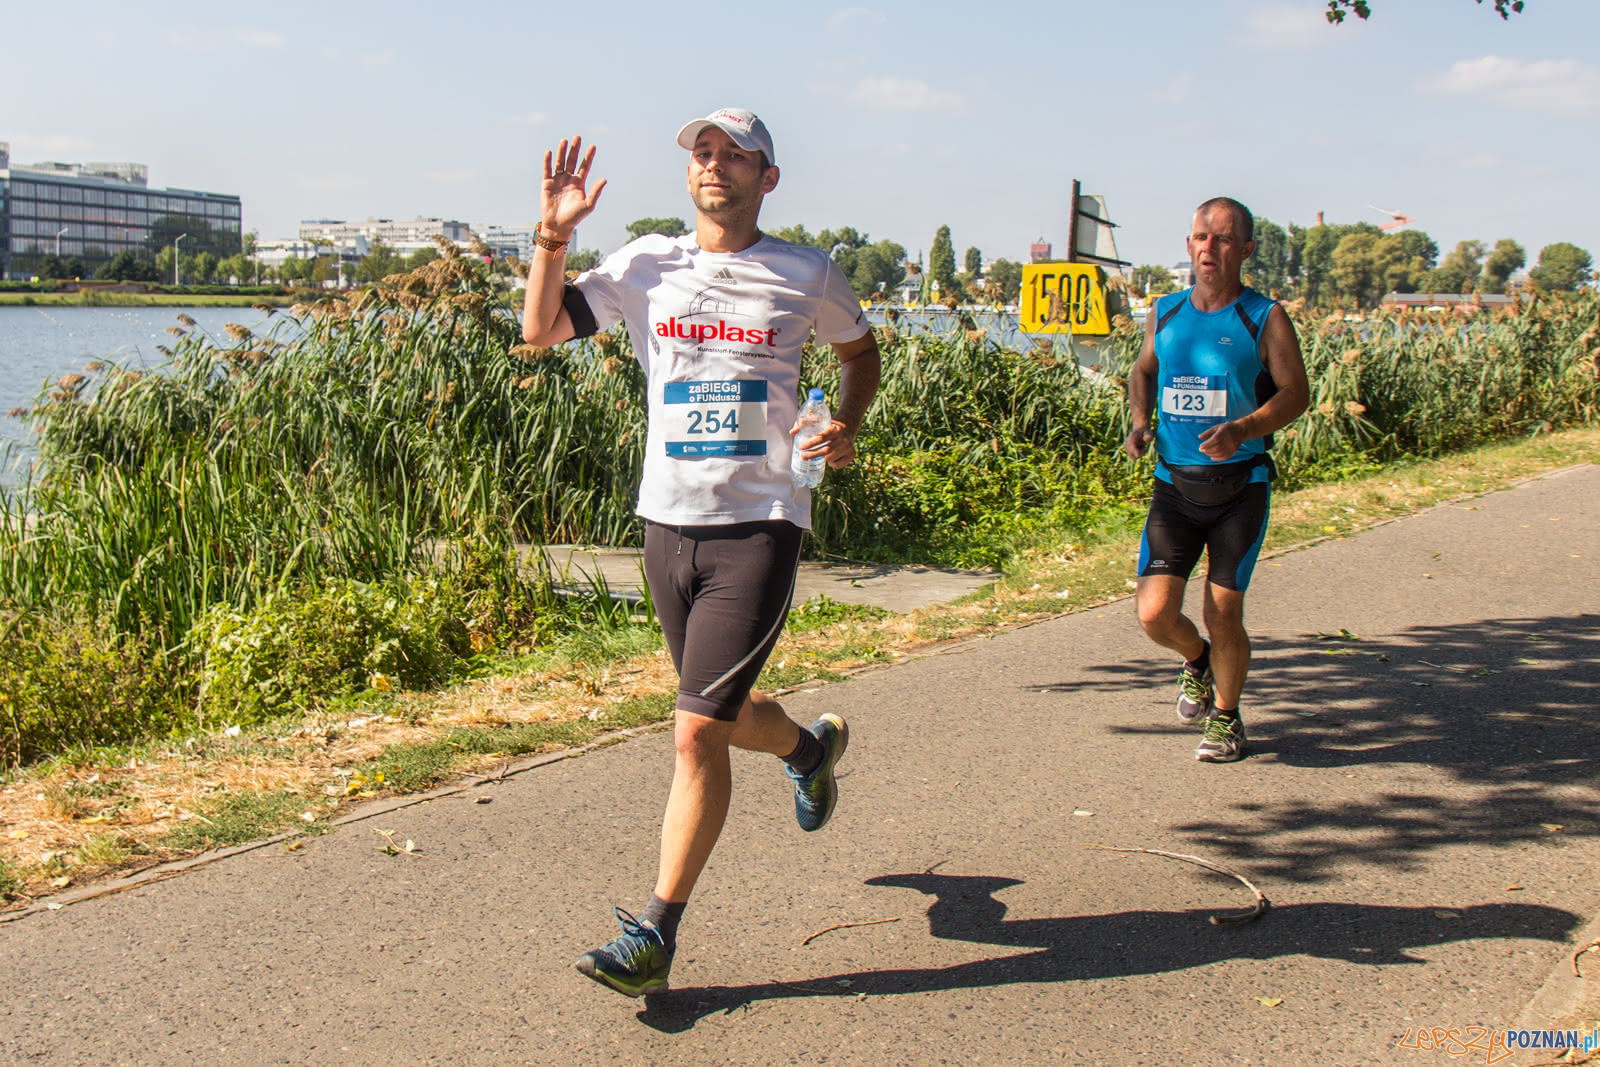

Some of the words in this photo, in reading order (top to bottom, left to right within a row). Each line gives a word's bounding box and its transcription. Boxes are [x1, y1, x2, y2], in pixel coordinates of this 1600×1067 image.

[1030, 273, 1089, 325] 1500
[656, 316, 778, 347] aluplast
[688, 382, 741, 394] zaBIEGaj
[1172, 376, 1208, 386] zaBIEGaj
[696, 394, 741, 402] FUNdusze
[1172, 394, 1205, 411] 123
[687, 408, 739, 434] 254
